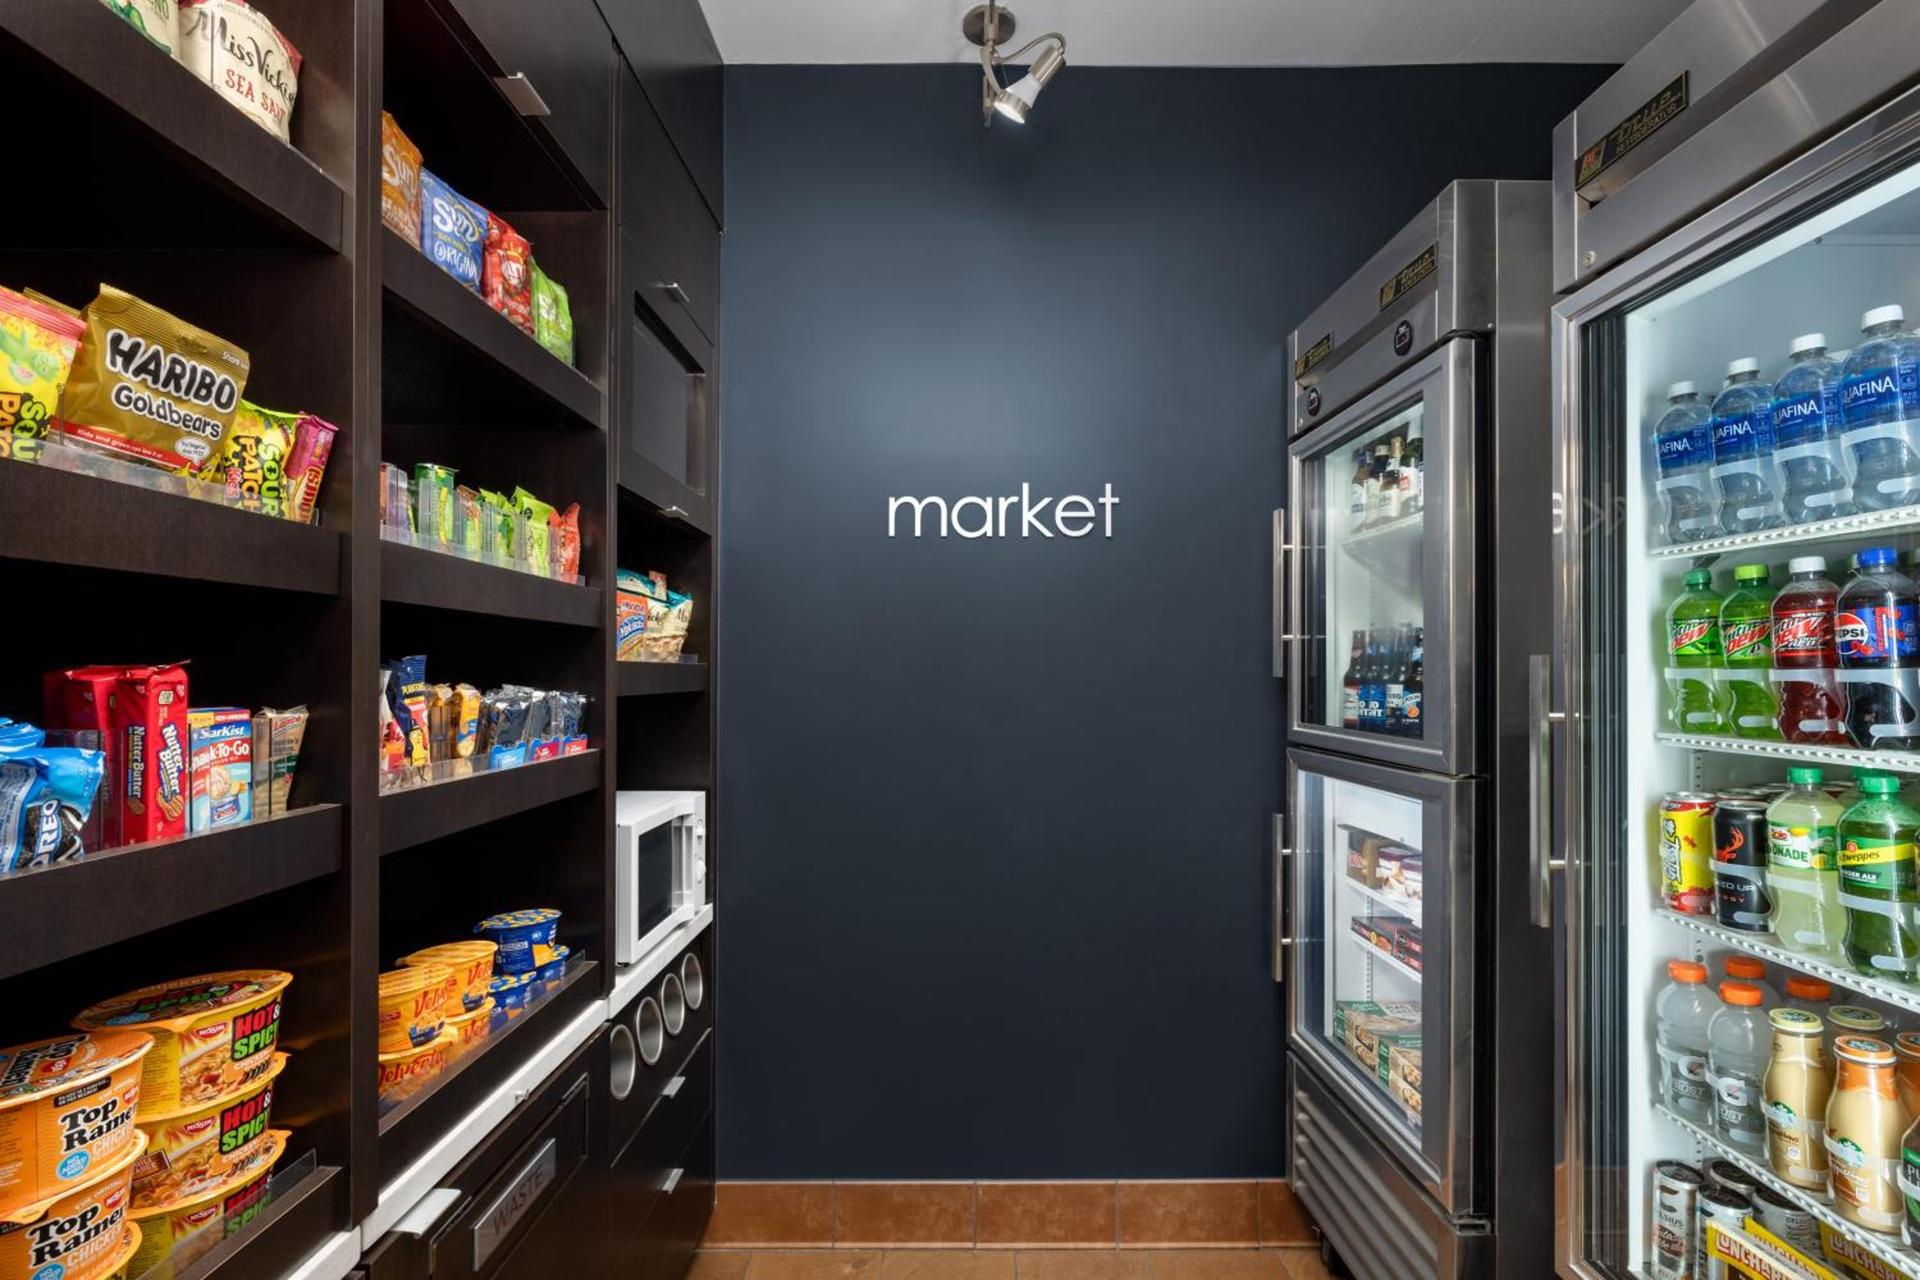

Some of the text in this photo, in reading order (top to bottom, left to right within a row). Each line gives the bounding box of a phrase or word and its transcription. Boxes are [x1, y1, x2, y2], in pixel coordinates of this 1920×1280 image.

[225, 68, 255, 102] SEA
[108, 331, 236, 410] HARIBO
[12, 400, 46, 459] SOU
[114, 384, 221, 439] Goldbears
[259, 443, 281, 518] SOUR
[888, 482, 1120, 538] market
[132, 726, 146, 798] Nutter Butter
[159, 748, 180, 794] Butter
[162, 723, 184, 770] Nutter
[61, 1098, 118, 1132] Top
[63, 1104, 135, 1152] Rame
[29, 1205, 99, 1245] Top
[31, 1203, 126, 1268] Rame
